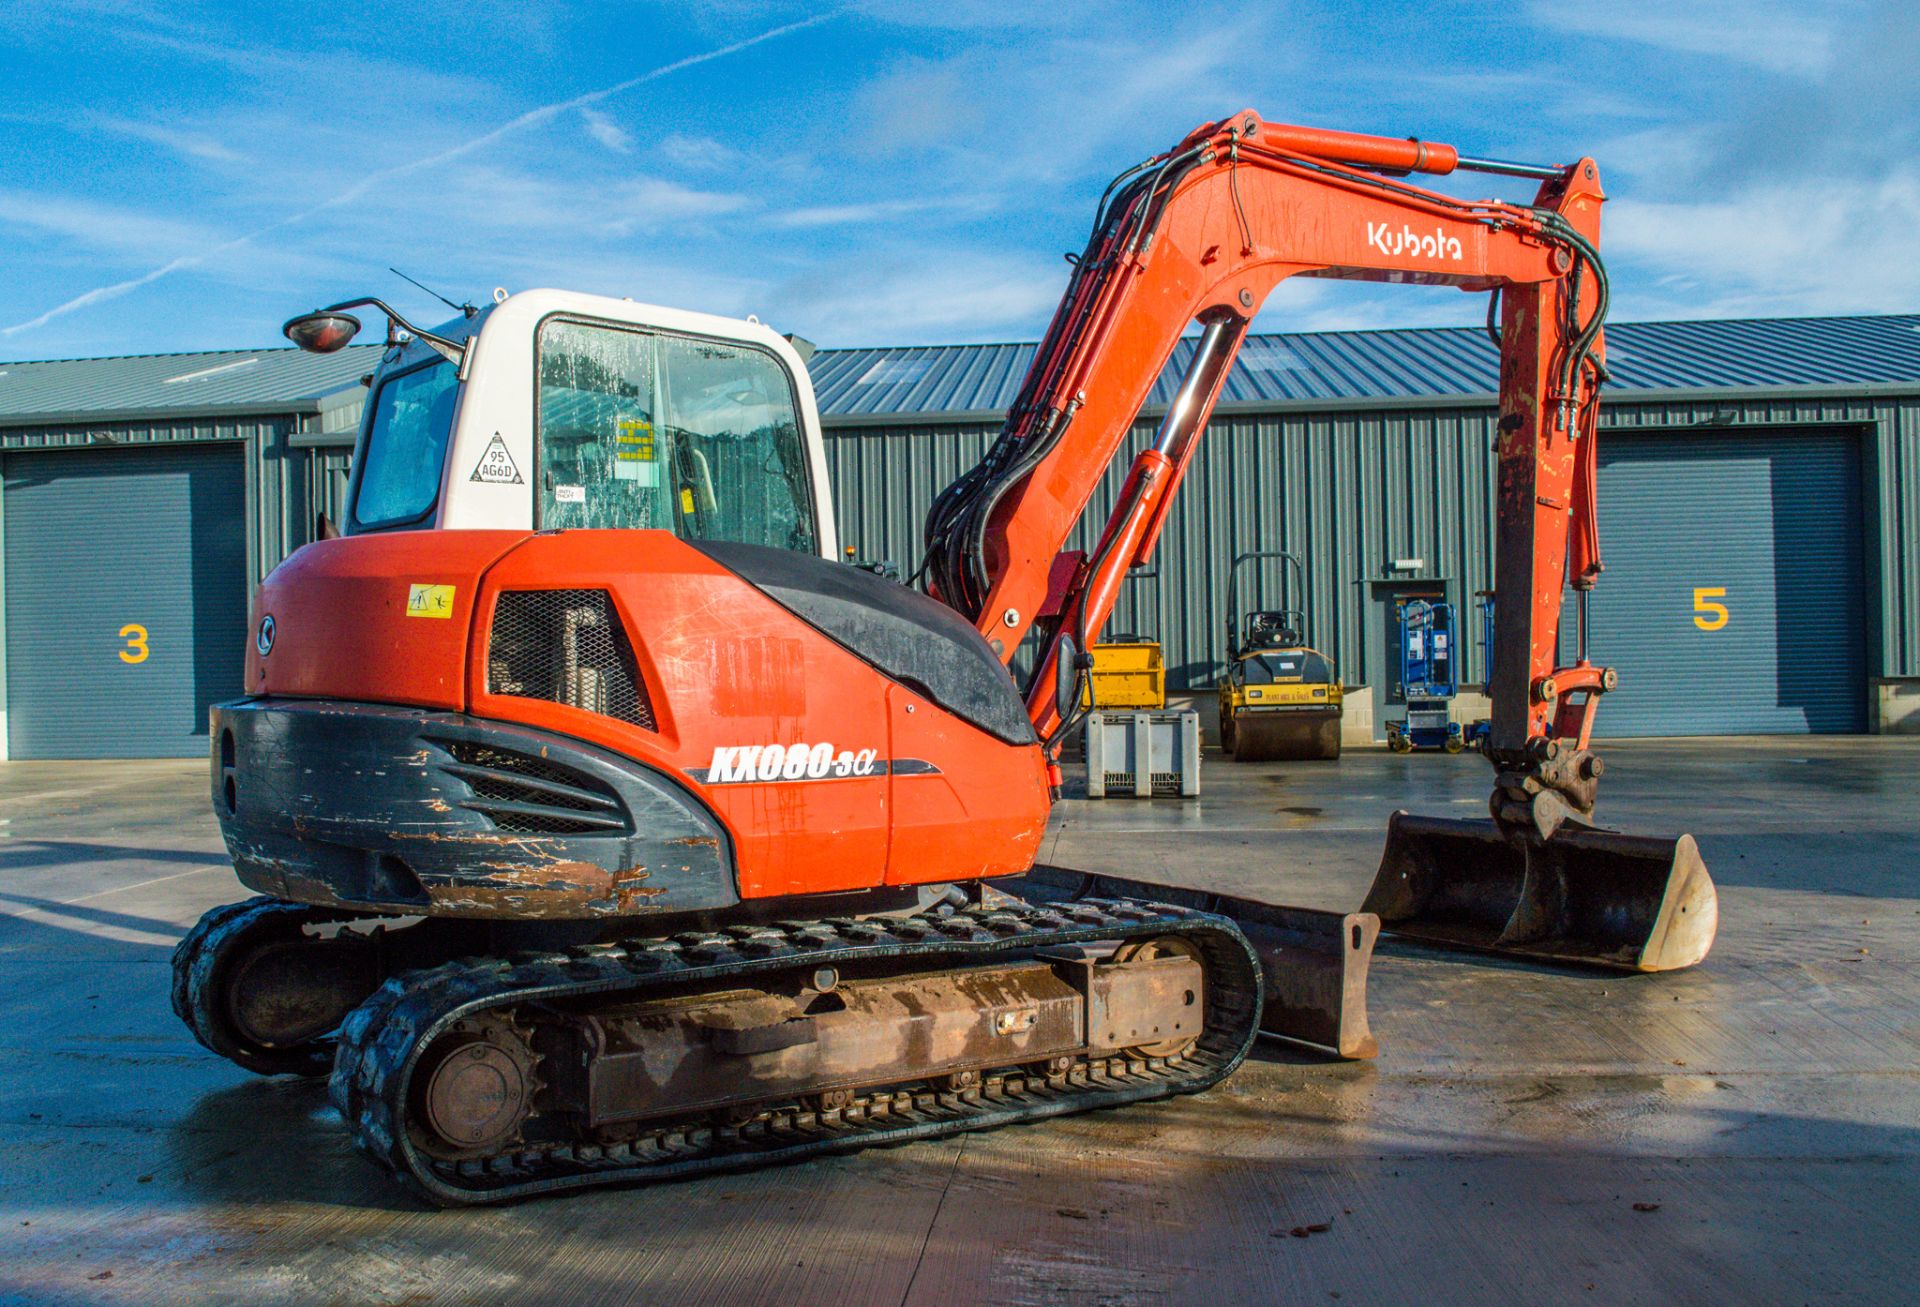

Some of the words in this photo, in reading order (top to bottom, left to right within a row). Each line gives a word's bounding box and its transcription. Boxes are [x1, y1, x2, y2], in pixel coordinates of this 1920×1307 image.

[1367, 222, 1462, 260] Kubota
[482, 464, 512, 477] AG6D
[490, 451, 505, 463] 95
[1693, 587, 1729, 631] 5
[118, 623, 150, 664] 3
